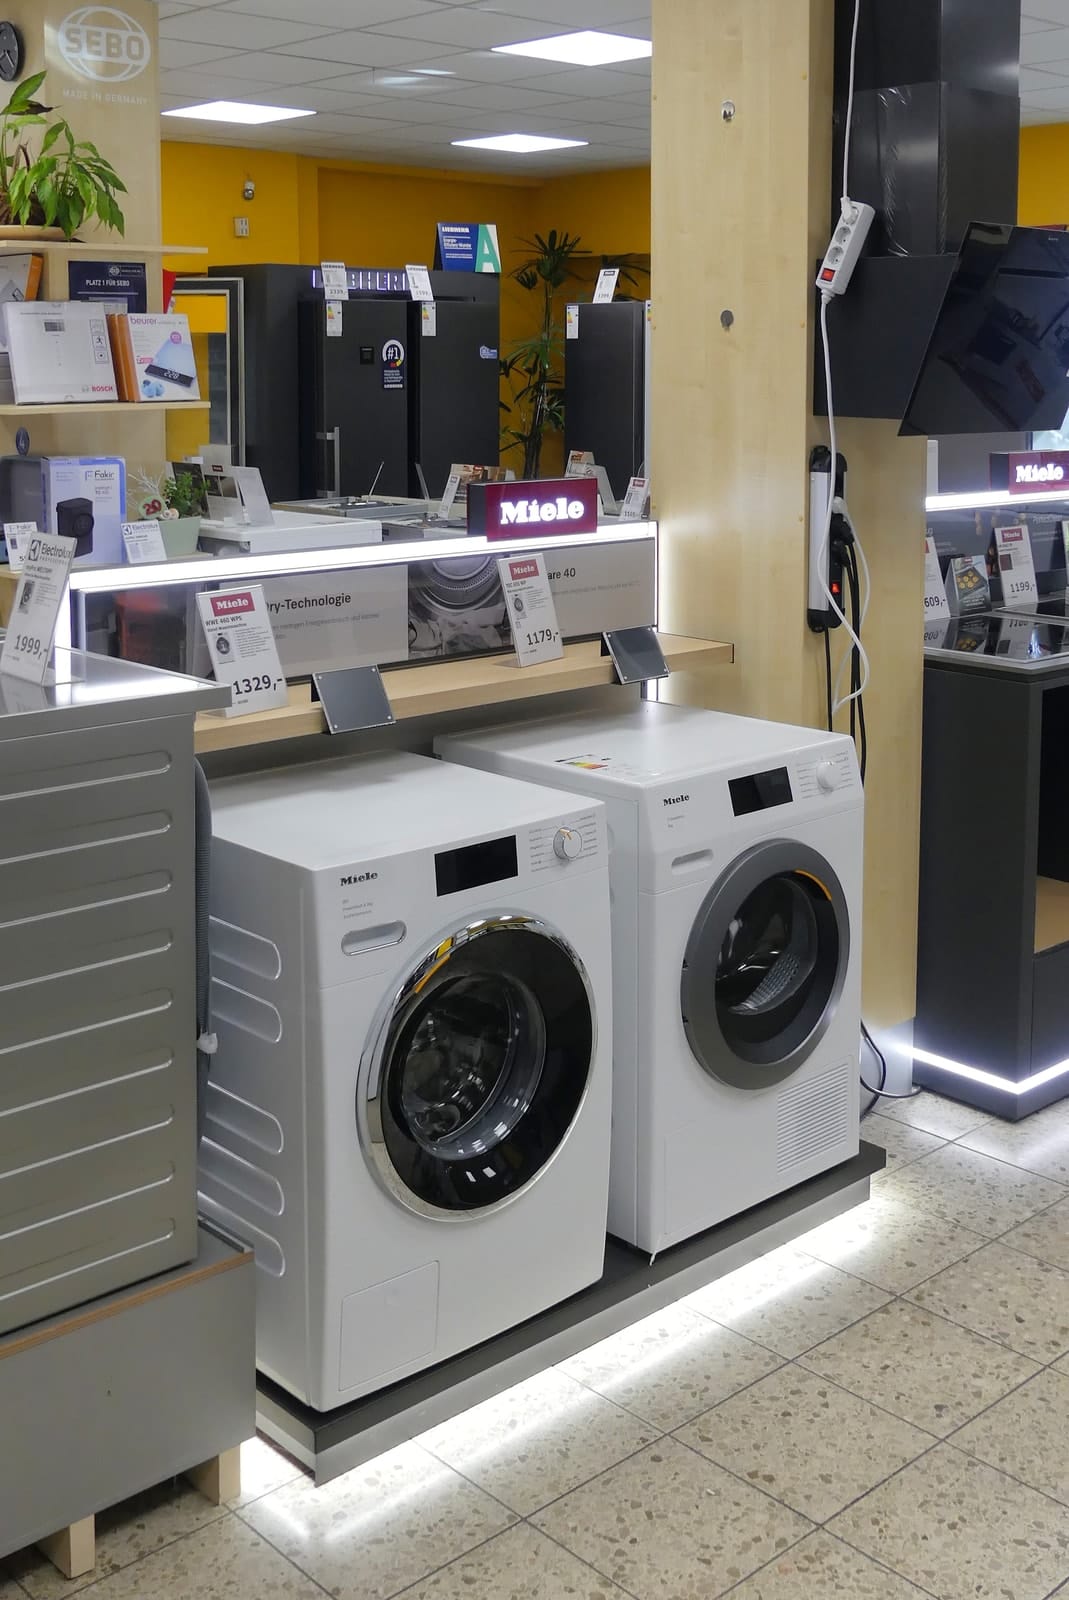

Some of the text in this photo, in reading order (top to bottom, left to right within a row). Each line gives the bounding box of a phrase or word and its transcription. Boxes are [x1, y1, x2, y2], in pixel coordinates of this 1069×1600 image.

[64, 28, 145, 61] SEBO
[63, 88, 89, 98] MADE
[104, 93, 148, 105] GERMANY
[475, 224, 502, 272] A
[85, 279, 102, 287] PLATZ
[106, 278, 116, 287] FÜR
[130, 316, 158, 325] beurer
[387, 347, 400, 360] #1
[94, 470, 115, 479] Fakir
[1015, 463, 1064, 483] Miele
[500, 497, 585, 525] Miele
[41, 543, 72, 559] Electrolux
[513, 564, 535, 576] Miele
[563, 567, 577, 578] 40
[1010, 580, 1036, 593] 1199,-
[215, 598, 249, 610] Miele
[526, 628, 560, 646] 1179,-
[15, 634, 49, 661] 1999,-
[233, 673, 284, 696] 1329,-
[663, 794, 690, 807] Miele
[340, 872, 378, 887] Miele
